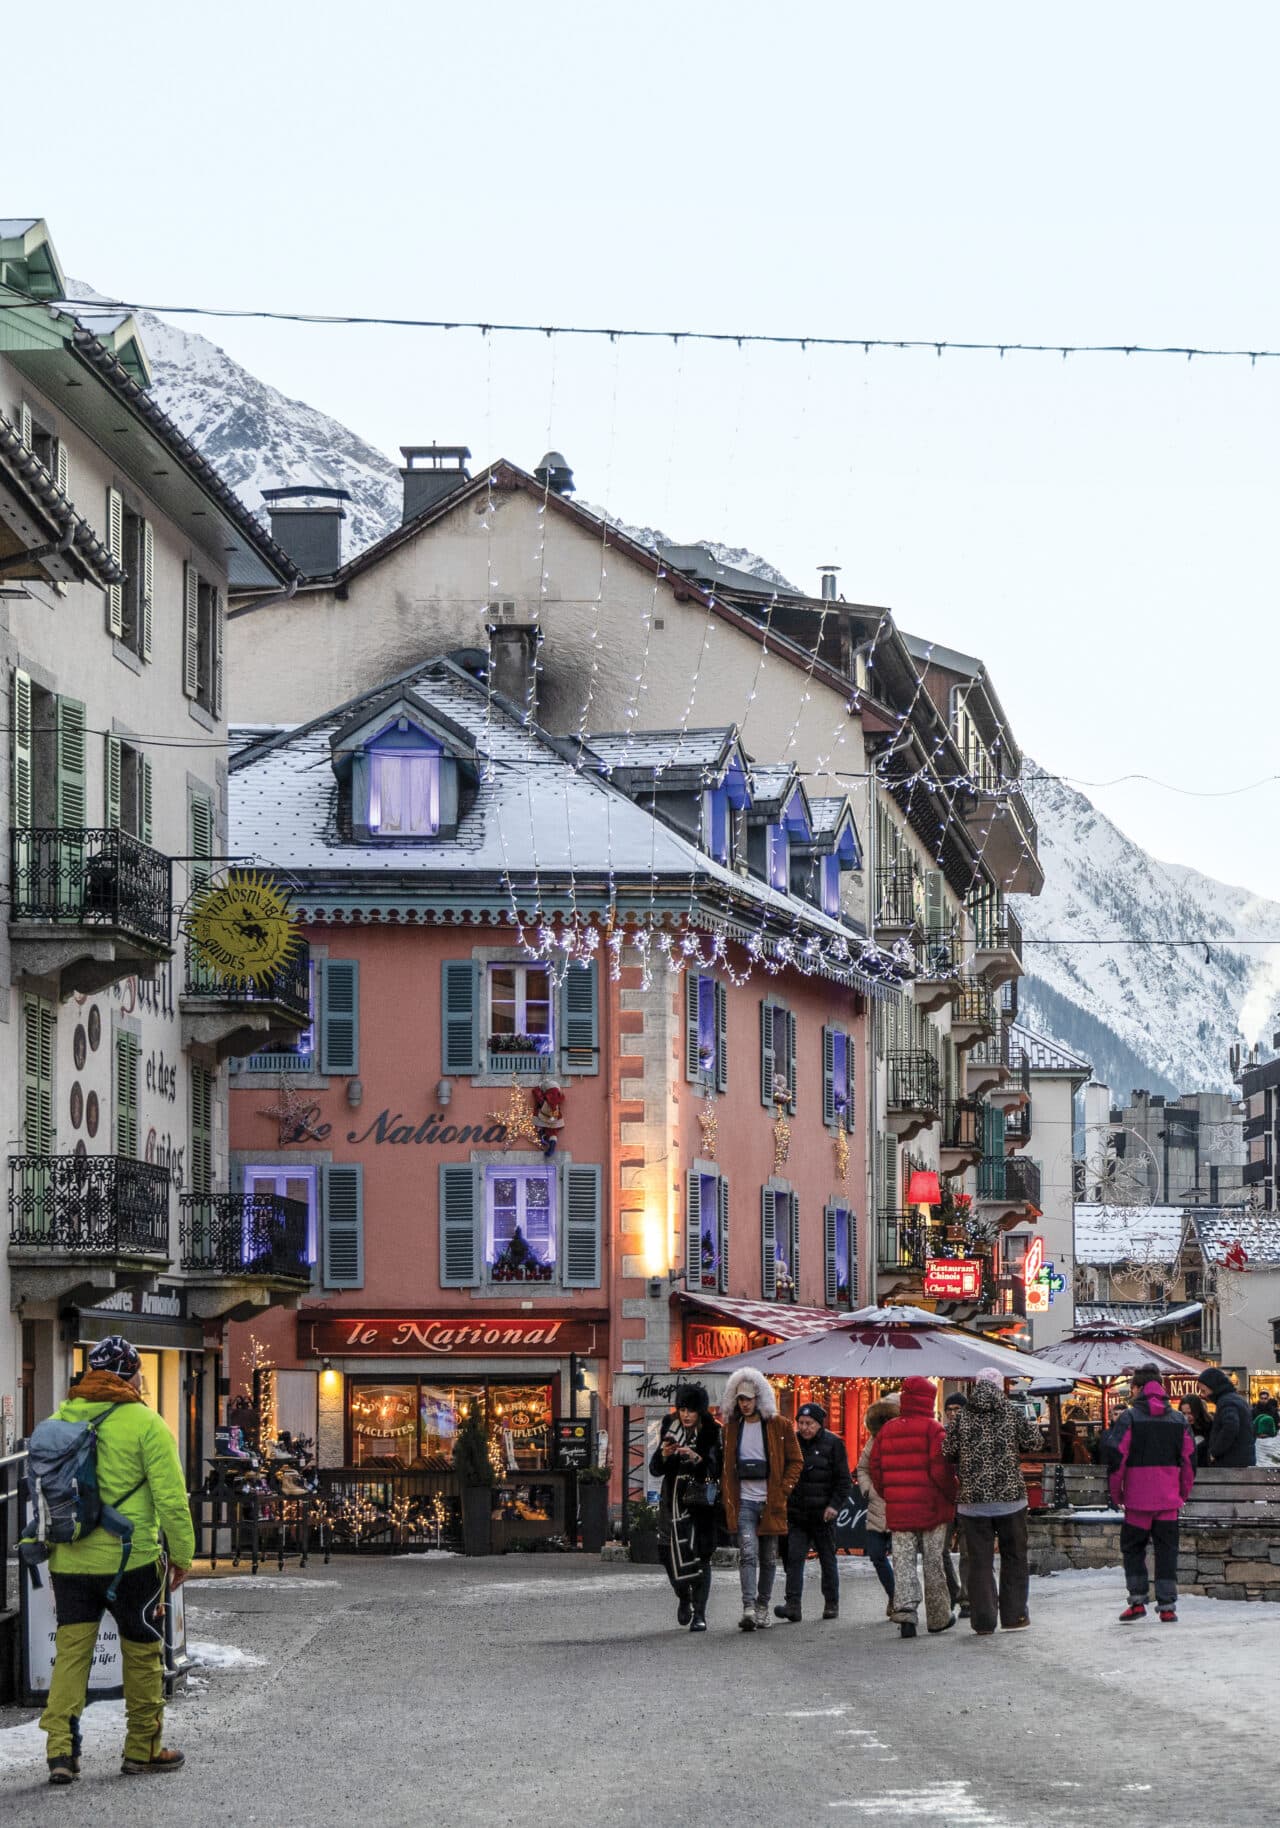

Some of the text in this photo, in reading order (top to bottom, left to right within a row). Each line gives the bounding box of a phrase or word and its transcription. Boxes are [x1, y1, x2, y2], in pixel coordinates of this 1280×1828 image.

[347, 1108, 512, 1144] Nationa
[930, 1264, 975, 1272] Restaurant
[930, 1271, 960, 1280] Chinois
[346, 1320, 563, 1352] le National
[696, 1330, 749, 1357] BRASSER
[356, 1423, 415, 1438] RACLETTES
[103, 1631, 117, 1641] bin
[98, 1653, 117, 1666] life!
